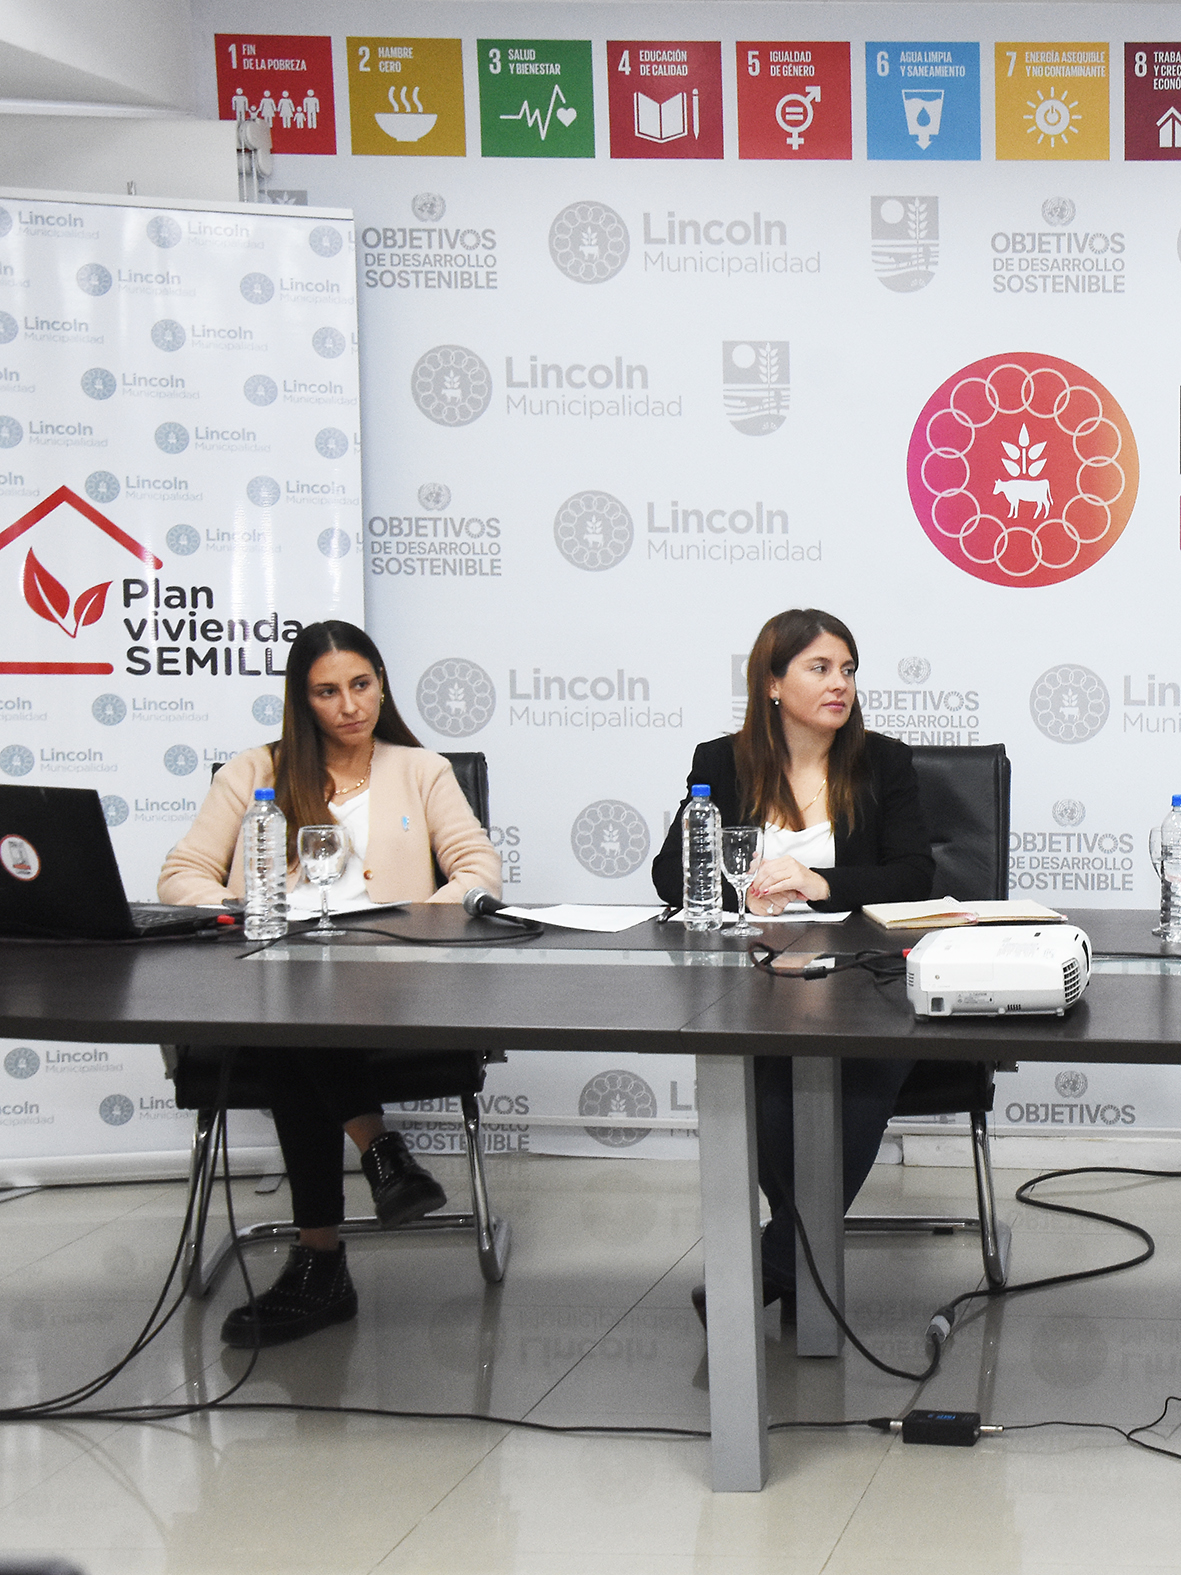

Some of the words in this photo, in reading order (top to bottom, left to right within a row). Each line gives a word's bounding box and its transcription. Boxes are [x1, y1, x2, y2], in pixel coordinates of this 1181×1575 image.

[228, 43, 237, 69] 1
[242, 44, 256, 55] FIN
[378, 47, 414, 59] HAMBRE
[508, 49, 536, 61] SALUD
[639, 48, 688, 62] EDUCACIÓN
[770, 51, 812, 63] IGUALDAD
[900, 52, 922, 63] AGUA
[923, 52, 952, 63] LIMPIA
[243, 59, 254, 70] DE
[256, 59, 266, 70] LA
[267, 59, 307, 71] POBREZA
[358, 46, 371, 72] 2
[489, 48, 502, 74] 3
[618, 50, 631, 75] 4
[747, 51, 761, 77] 5
[876, 51, 890, 77] 6
[1005, 52, 1017, 77] 7
[1061, 52, 1105, 64] ASEQUIBLE
[1134, 51, 1147, 78] 8
[379, 61, 401, 73] CERO
[508, 63, 515, 74] Y
[516, 63, 561, 76] BIENESTAR
[640, 65, 651, 76] DE
[652, 65, 689, 77] CALIDAD
[770, 66, 782, 77] DE
[782, 63, 815, 77] GÉNERO
[900, 66, 906, 77] Y
[907, 65, 965, 77] SANEAMIENTO
[1026, 66, 1032, 77] Y
[1032, 66, 1044, 77] NO
[1044, 65, 1106, 78] CONTAMINANTE
[1154, 65, 1160, 77] Y
[19, 211, 83, 227] Lincoln
[643, 211, 786, 245] Lincoln
[362, 227, 497, 251] OBJETIVOS
[991, 232, 1125, 255] OBJETIVOS
[364, 253, 388, 268] DE
[390, 253, 496, 268] DESARROLLO
[644, 251, 820, 278] Municipalidad
[993, 258, 1014, 271] DE
[1018, 258, 1125, 272] DESARROLLO
[117, 269, 180, 284] Lincoln
[365, 269, 498, 289] SOSTENIBLE
[993, 274, 1124, 293] SOSTENIBLE
[24, 316, 88, 333] Lincoln
[192, 325, 253, 339] Lincoln
[506, 355, 648, 389] Lincoln
[122, 373, 185, 388] Lincoln
[506, 394, 682, 419] Municipalidad
[29, 421, 93, 437] Lincoln
[195, 427, 256, 442] Lincoln
[126, 476, 188, 490] Lincoln
[647, 501, 788, 534] Lincoln
[368, 516, 500, 539] OBJETIVOS
[371, 541, 394, 555] DE
[396, 541, 500, 555] DESARROLLO
[648, 539, 821, 564] Municipalidad
[371, 557, 500, 577] SOSTENIBLE
[123, 579, 213, 609] Plan
[124, 611, 303, 642] vivienda
[126, 646, 287, 676] SEMILL
[509, 668, 649, 701] Lincoln
[132, 698, 194, 711] Lincoln
[510, 706, 682, 731] Municipalidad
[875, 714, 979, 728] DESARROLLO
[41, 748, 102, 761] Lincoln
[1029, 857, 1133, 870] DESARROLLO
[46, 1049, 108, 1063] Lincoln
[1006, 1103, 1135, 1124] OBJETIVOS
[403, 1133, 529, 1151] SOSTEIBLE
